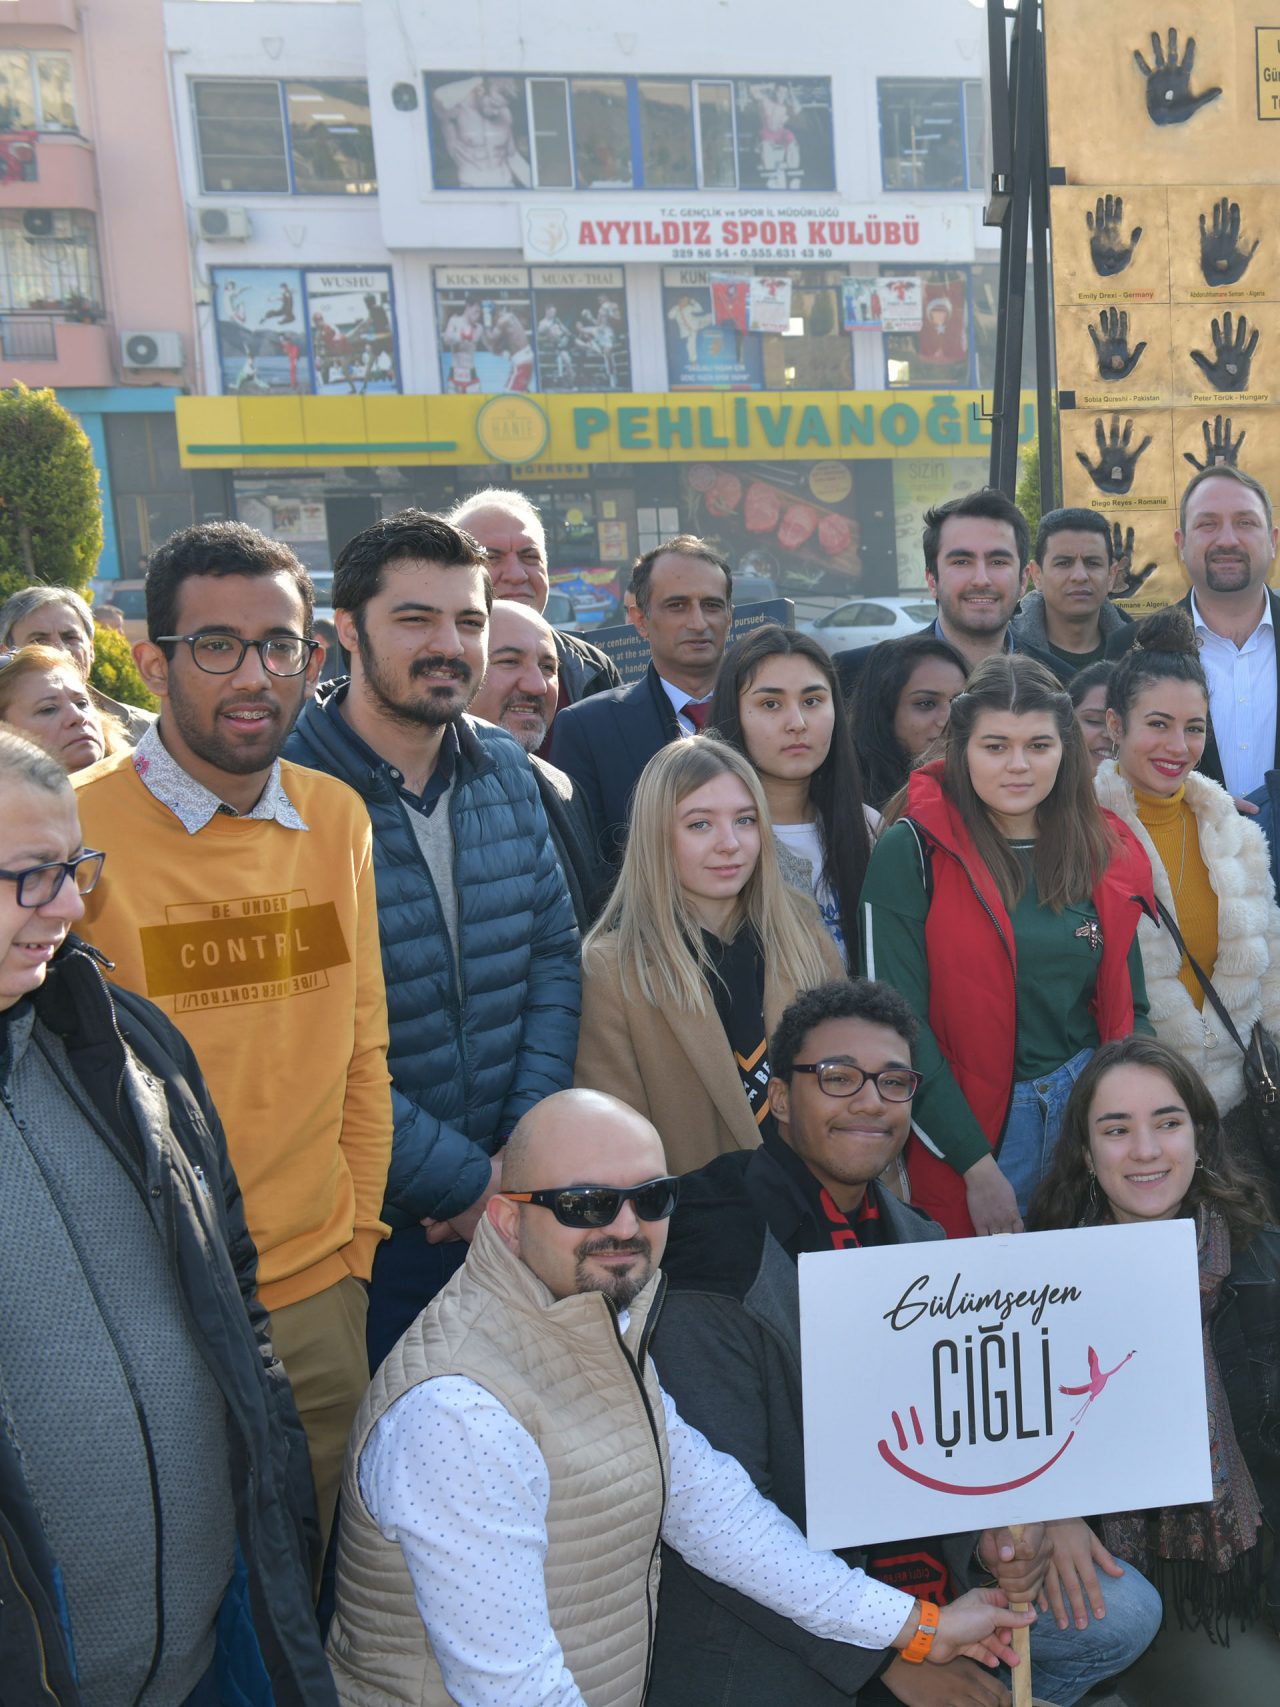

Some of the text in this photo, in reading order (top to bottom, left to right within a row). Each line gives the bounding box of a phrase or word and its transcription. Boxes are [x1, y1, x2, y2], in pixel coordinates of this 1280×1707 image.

[738, 208, 765, 217] SPOR
[578, 214, 920, 245] AYYILDIZ SPOR KULÜBÜ
[320, 276, 375, 288] WUSHU
[446, 273, 520, 286] KICK BOKS
[541, 274, 577, 285] MUAY
[734, 612, 765, 629] pursued
[607, 635, 642, 649] centuries,
[616, 652, 624, 661] at
[625, 650, 638, 659] the
[211, 897, 288, 919] BE UNDER
[882, 1272, 1082, 1331] Gülümseyen
[932, 1321, 1053, 1458] ÇİĞLİ
